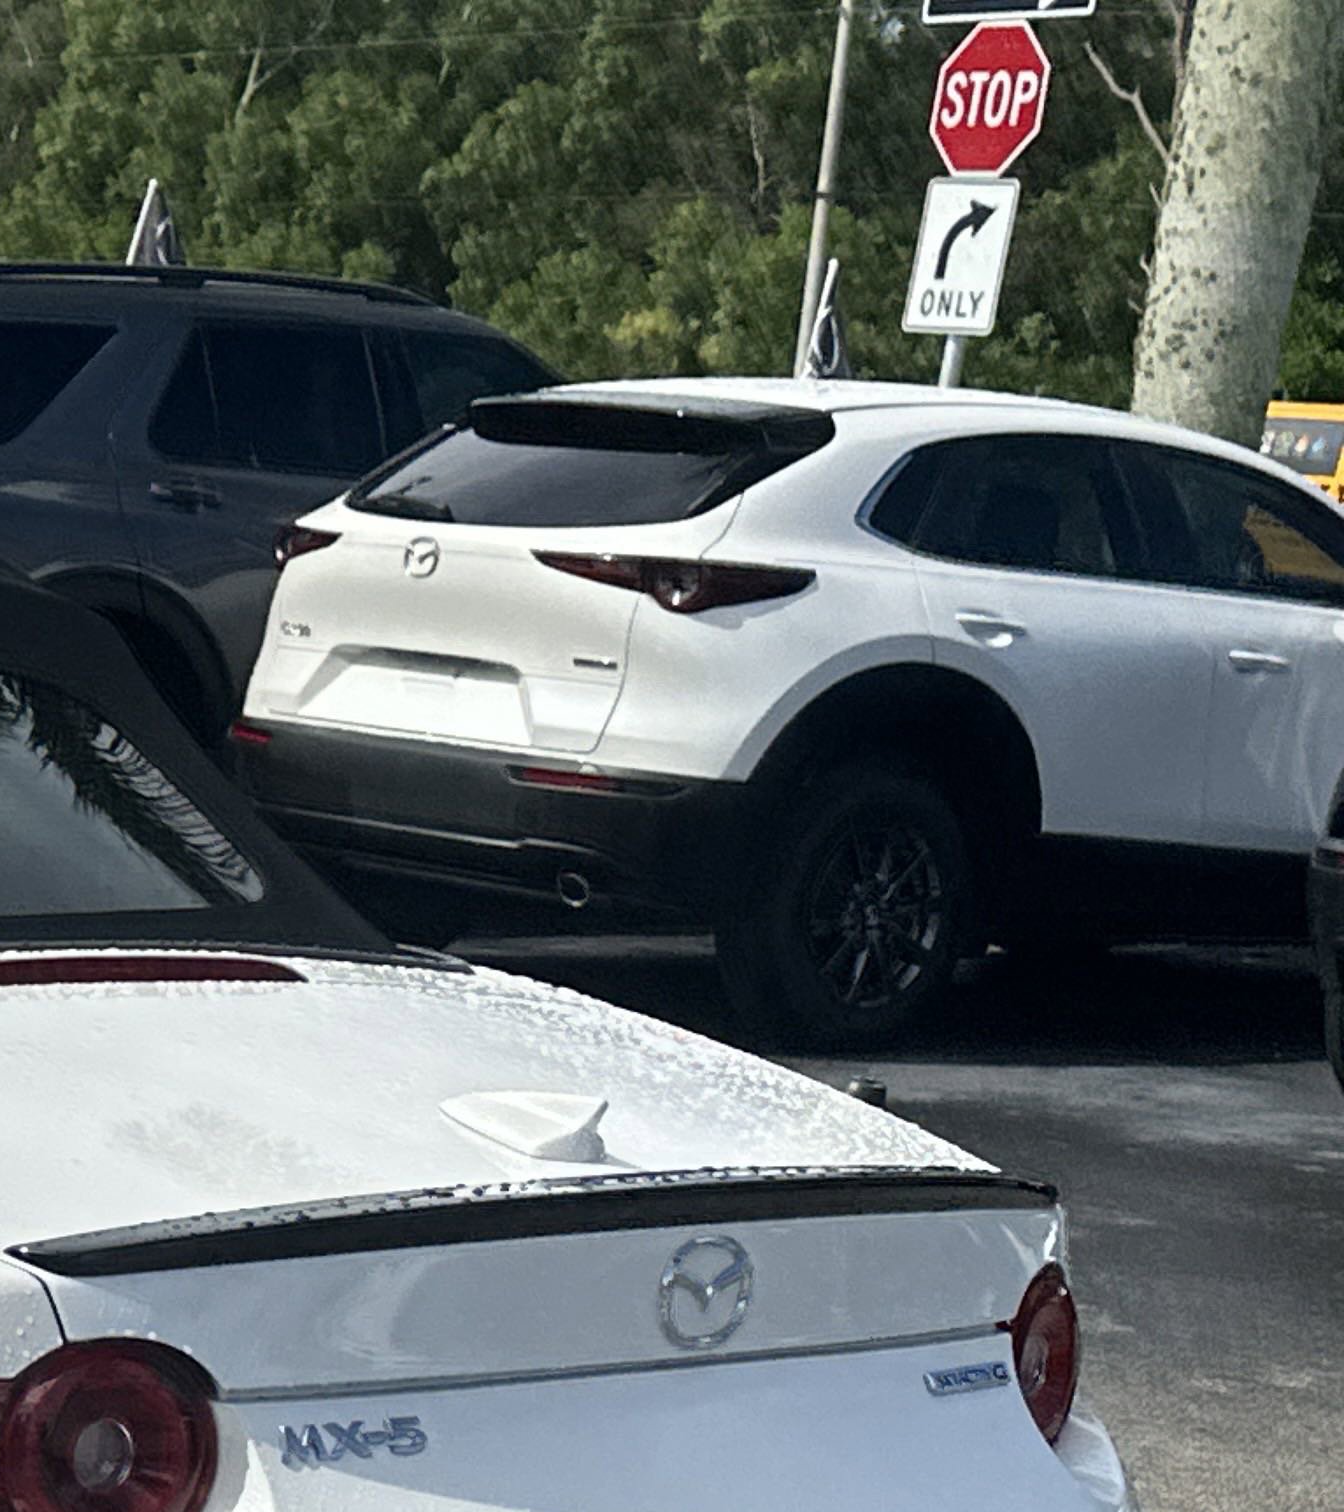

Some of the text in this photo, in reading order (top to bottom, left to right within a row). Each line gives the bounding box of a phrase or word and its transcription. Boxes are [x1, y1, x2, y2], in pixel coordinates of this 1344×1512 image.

[941, 71, 1039, 128] STOP
[920, 288, 985, 318] ONLY
[278, 1416, 428, 1471] MX-5
